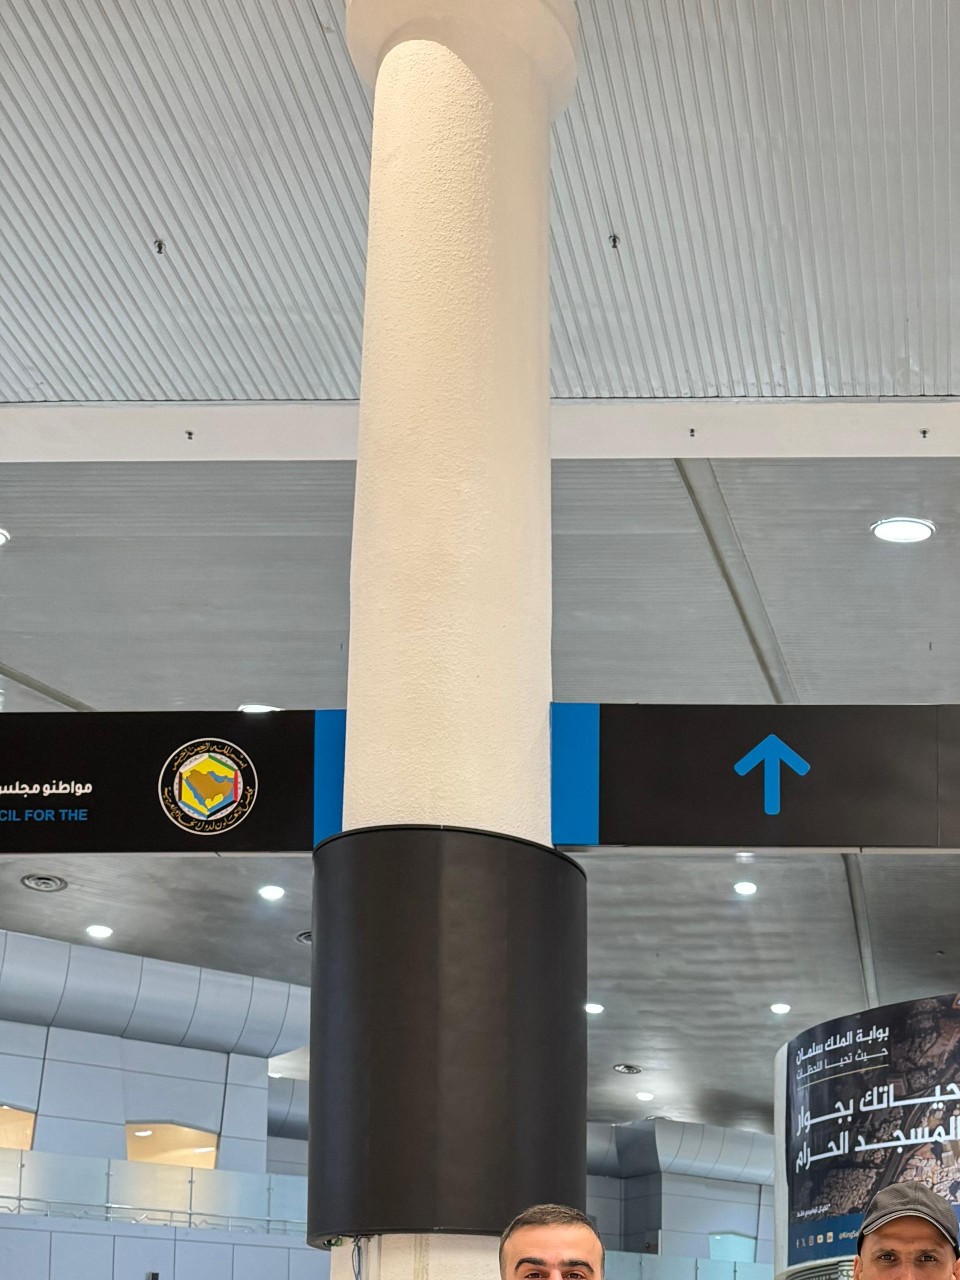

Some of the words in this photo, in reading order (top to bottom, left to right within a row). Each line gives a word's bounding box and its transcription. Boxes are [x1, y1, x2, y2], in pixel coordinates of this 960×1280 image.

[43, 780, 93, 797] مواطنو
[24, 809, 55, 822] FOR
[59, 809, 88, 821] THE
[825, 1031, 853, 1050] الملك
[856, 1025, 889, 1044] بوابة
[796, 1042, 823, 1065] سلمان
[796, 1099, 854, 1136] بجوار
[796, 1130, 849, 1173] الحرام
